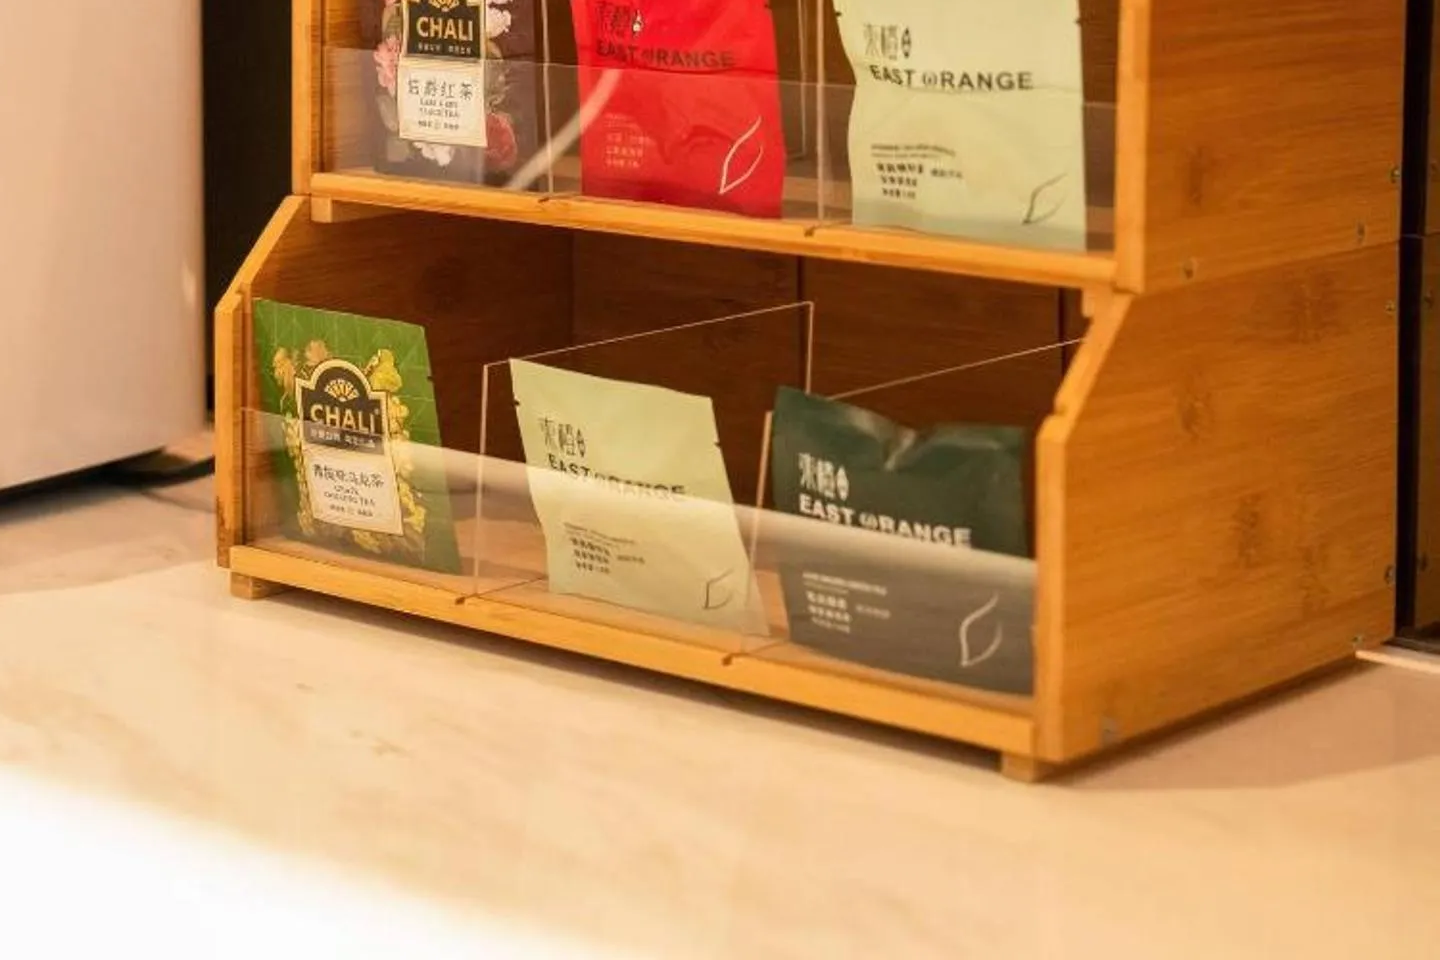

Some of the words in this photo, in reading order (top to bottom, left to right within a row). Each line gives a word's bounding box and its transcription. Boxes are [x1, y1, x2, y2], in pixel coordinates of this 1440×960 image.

[416, 16, 474, 42] CHALI
[596, 39, 637, 63] EAST
[869, 64, 915, 87] EAST
[310, 403, 376, 435] CHALI
[547, 452, 591, 477] EAST
[799, 493, 855, 528] EAST
